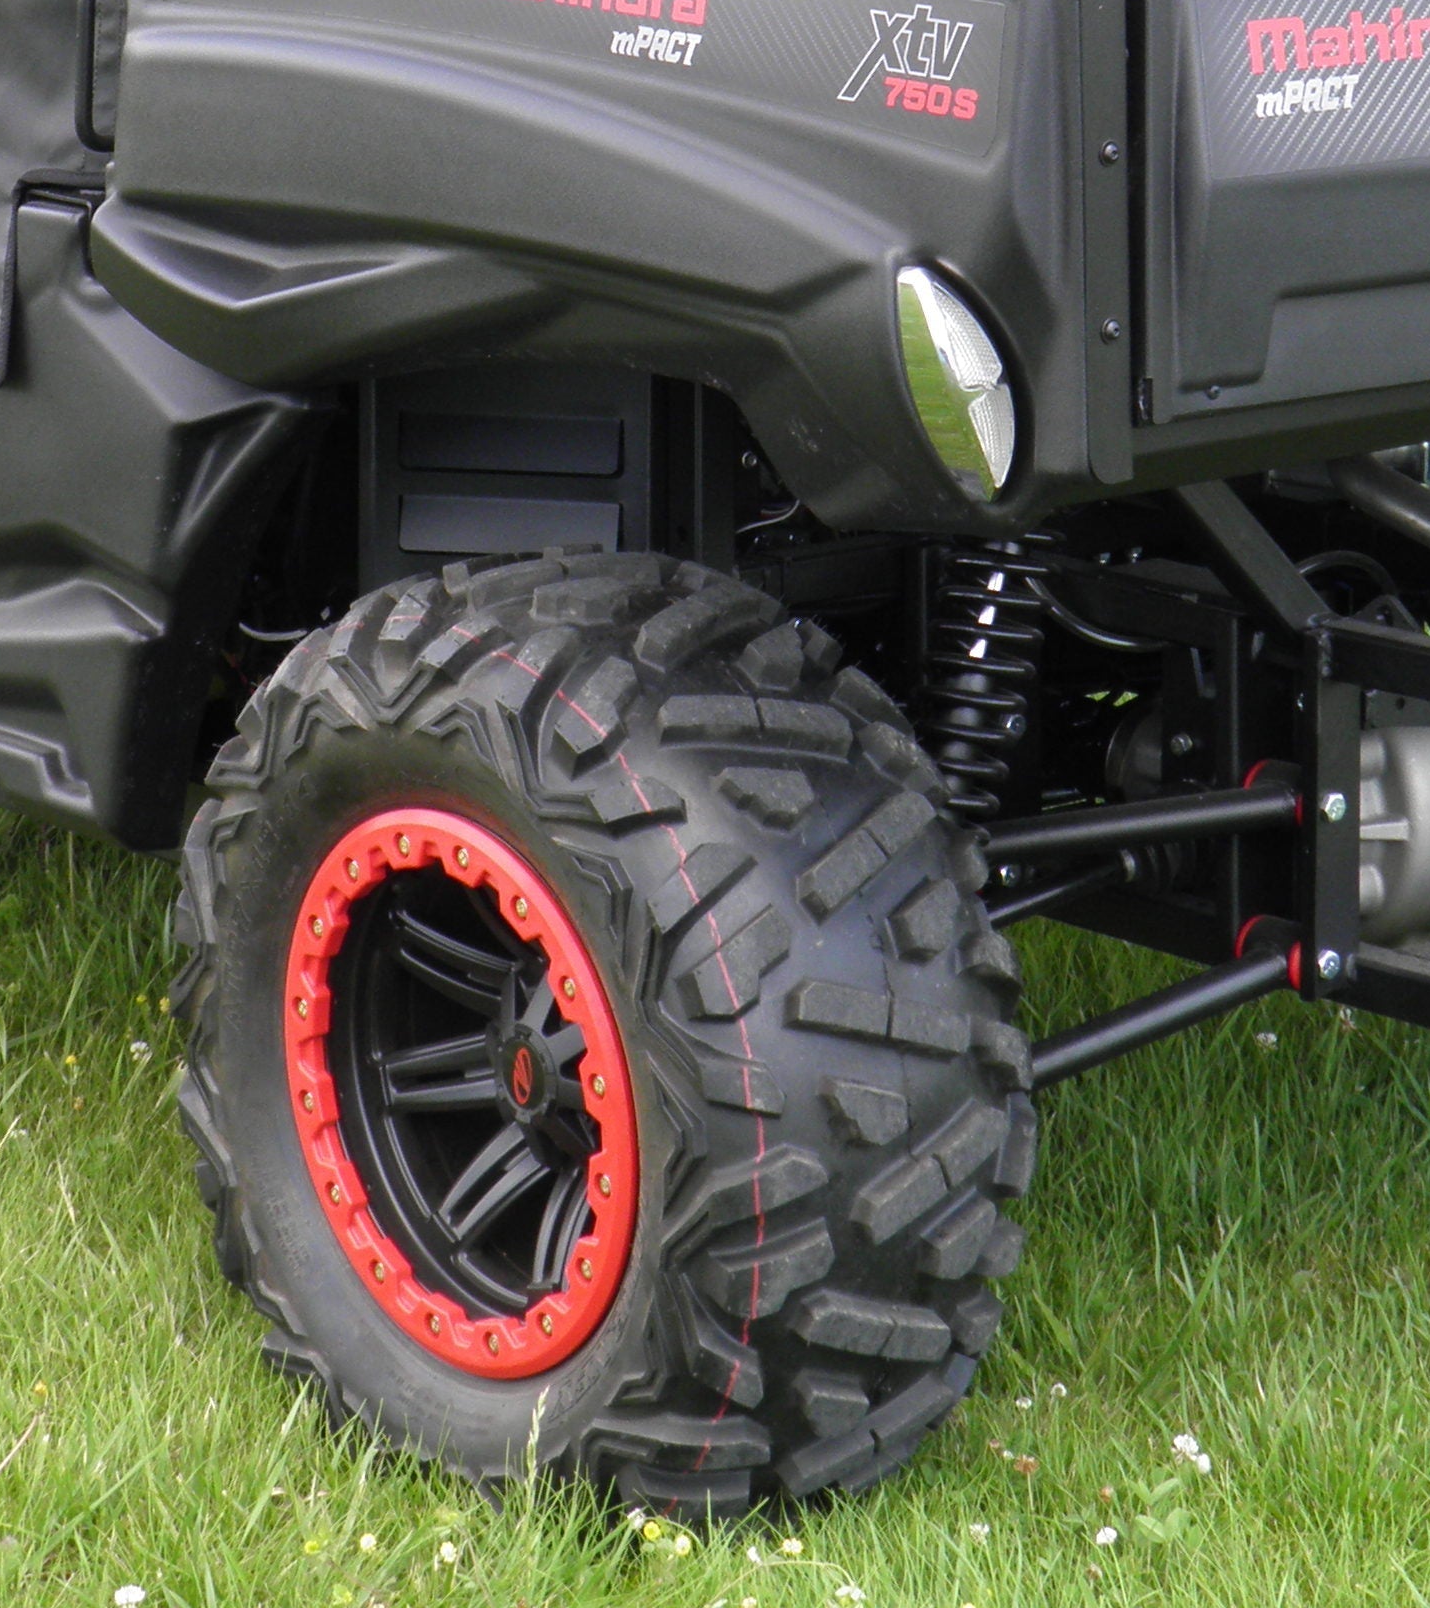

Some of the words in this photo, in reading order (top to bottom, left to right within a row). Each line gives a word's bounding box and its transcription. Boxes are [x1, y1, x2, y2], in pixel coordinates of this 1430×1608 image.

[610, 25, 703, 67] mPACT
[883, 76, 979, 120] 750S
[1256, 74, 1359, 118] mPACT
